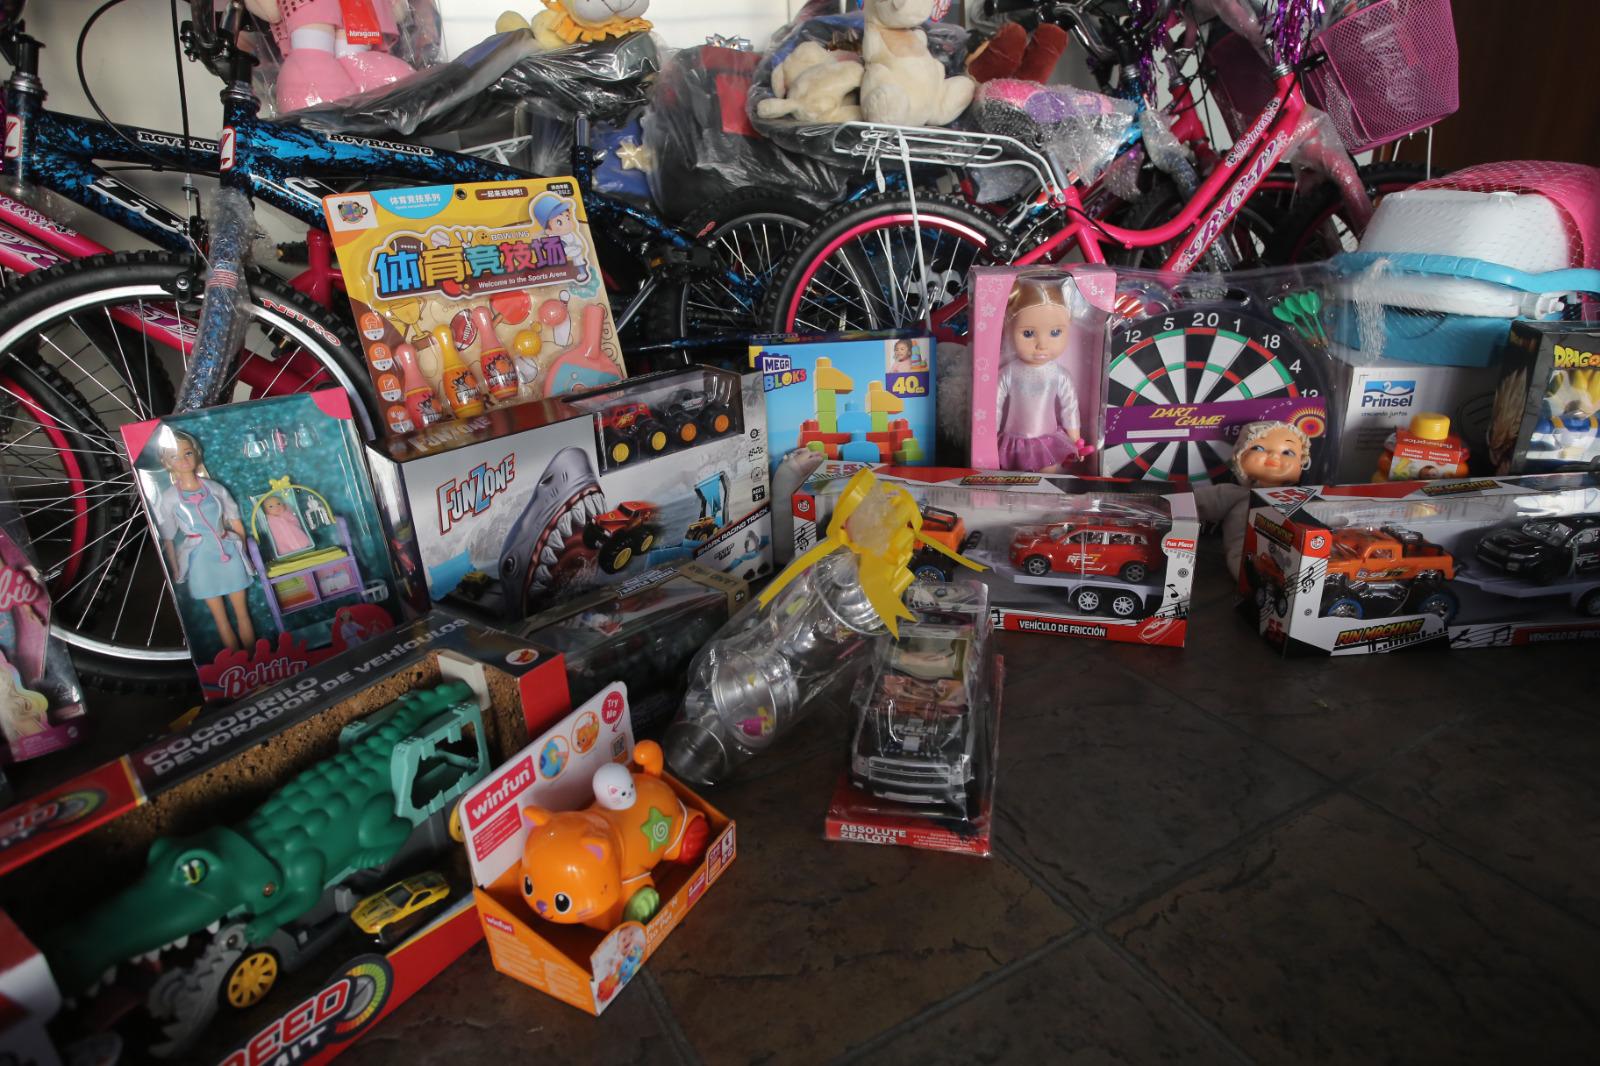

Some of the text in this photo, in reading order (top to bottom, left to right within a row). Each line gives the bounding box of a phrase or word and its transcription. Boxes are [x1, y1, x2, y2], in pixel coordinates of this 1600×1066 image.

[327, 134, 434, 156] RCV RACING
[490, 230, 530, 241] BOWLING
[374, 235, 567, 295] 体育竞技场
[478, 271, 567, 289] Welcome to the Sports Arena
[260, 298, 341, 347] NITRO
[1162, 317, 1175, 330] 5
[1191, 312, 1220, 327] 20
[1233, 318, 1241, 332] 1
[1124, 329, 1142, 343] 12
[1262, 334, 1281, 349] 18
[764, 358, 790, 371] MEGA
[1289, 359, 1302, 374] 4
[763, 368, 807, 391] BLOKS
[892, 375, 917, 395] 40
[1361, 393, 1413, 407] Prinsel
[1149, 406, 1198, 418] DART
[1174, 415, 1226, 427] GAME
[720, 522, 747, 542] RACING
[745, 508, 769, 527] TRACK
[1018, 619, 1106, 637] VEHÍCULO DE FRICCIÓN
[1335, 617, 1425, 646] FUN MACHINE
[607, 699, 619, 709] Try
[143, 677, 318, 766] COCODRILO
[606, 710, 618, 719] Me
[153, 688, 320, 776] DEVORADOR
[321, 671, 355, 691] DE
[471, 767, 531, 820] winfun
[839, 823, 906, 838] ABSOLUTE
[839, 831, 897, 844] ZEALOTS
